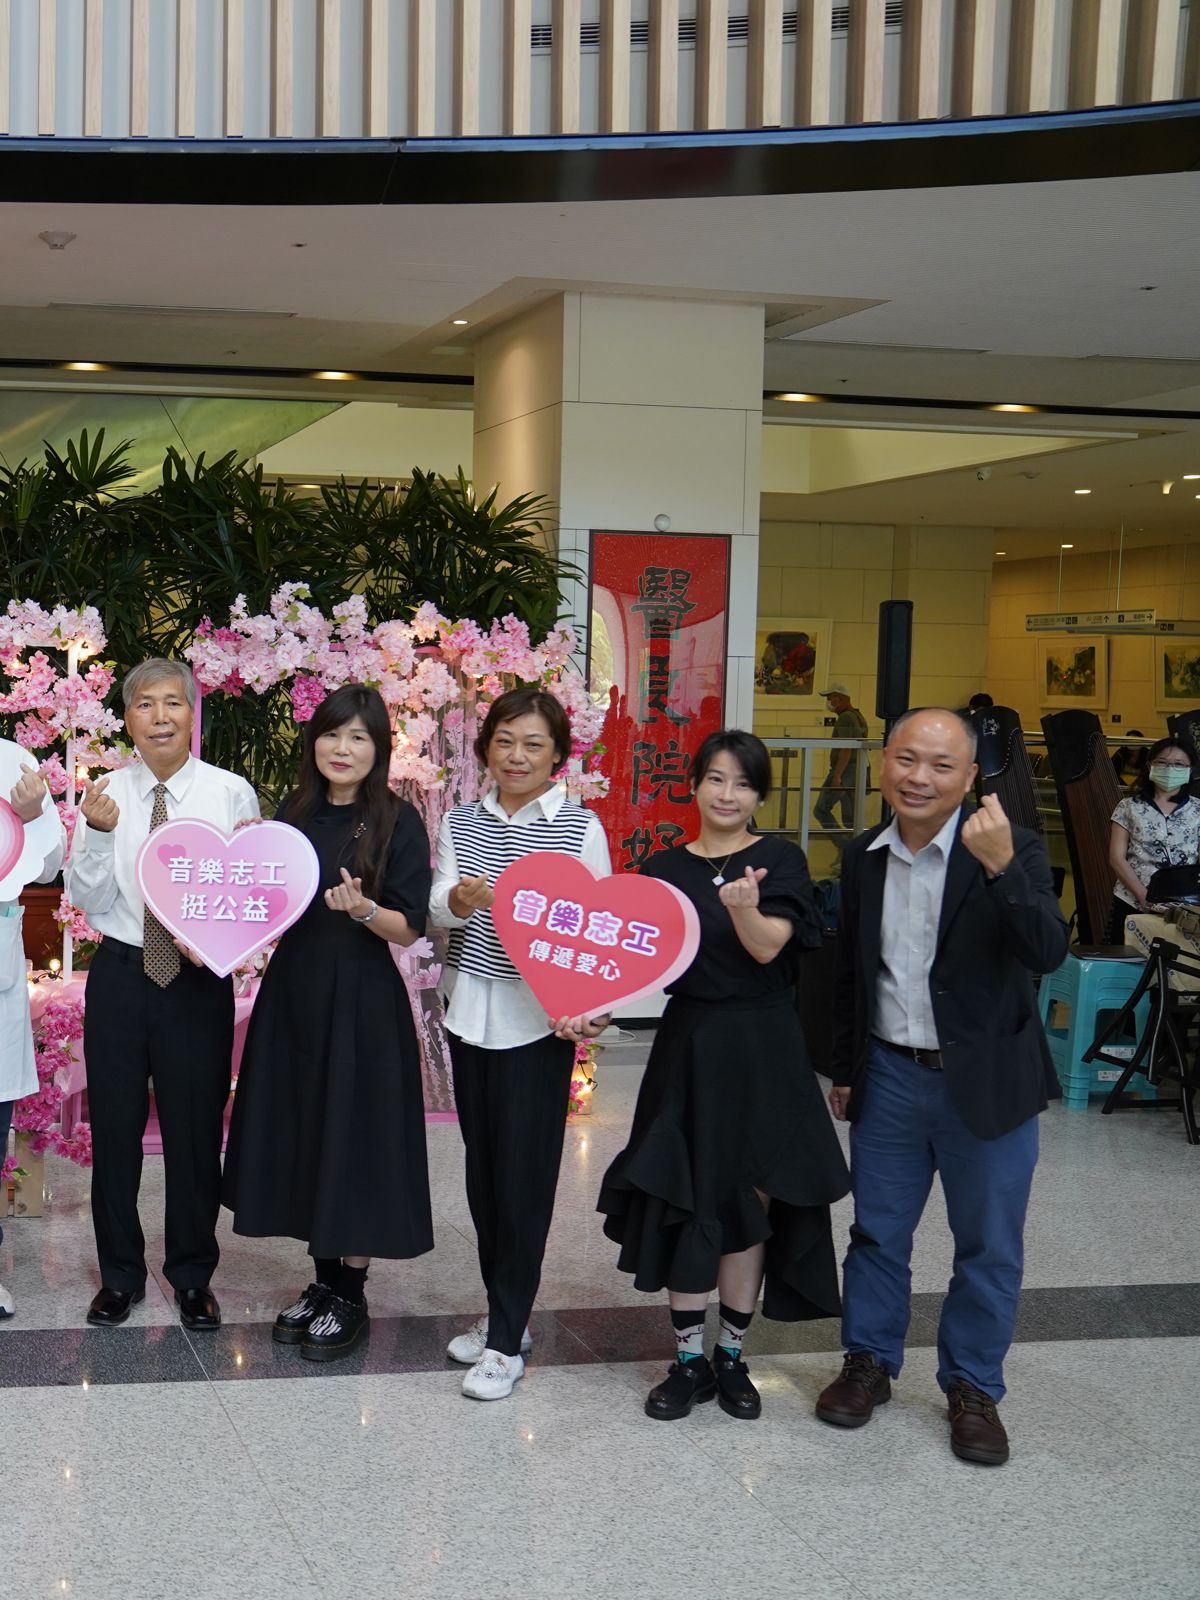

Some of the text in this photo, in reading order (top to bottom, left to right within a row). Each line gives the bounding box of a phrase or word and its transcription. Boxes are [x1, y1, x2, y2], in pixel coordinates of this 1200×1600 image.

[168, 856, 286, 886] 音樂志工
[181, 893, 269, 922] 挺公益
[513, 890, 658, 955] 音樂志工
[528, 938, 621, 981] 傳遞愛心
